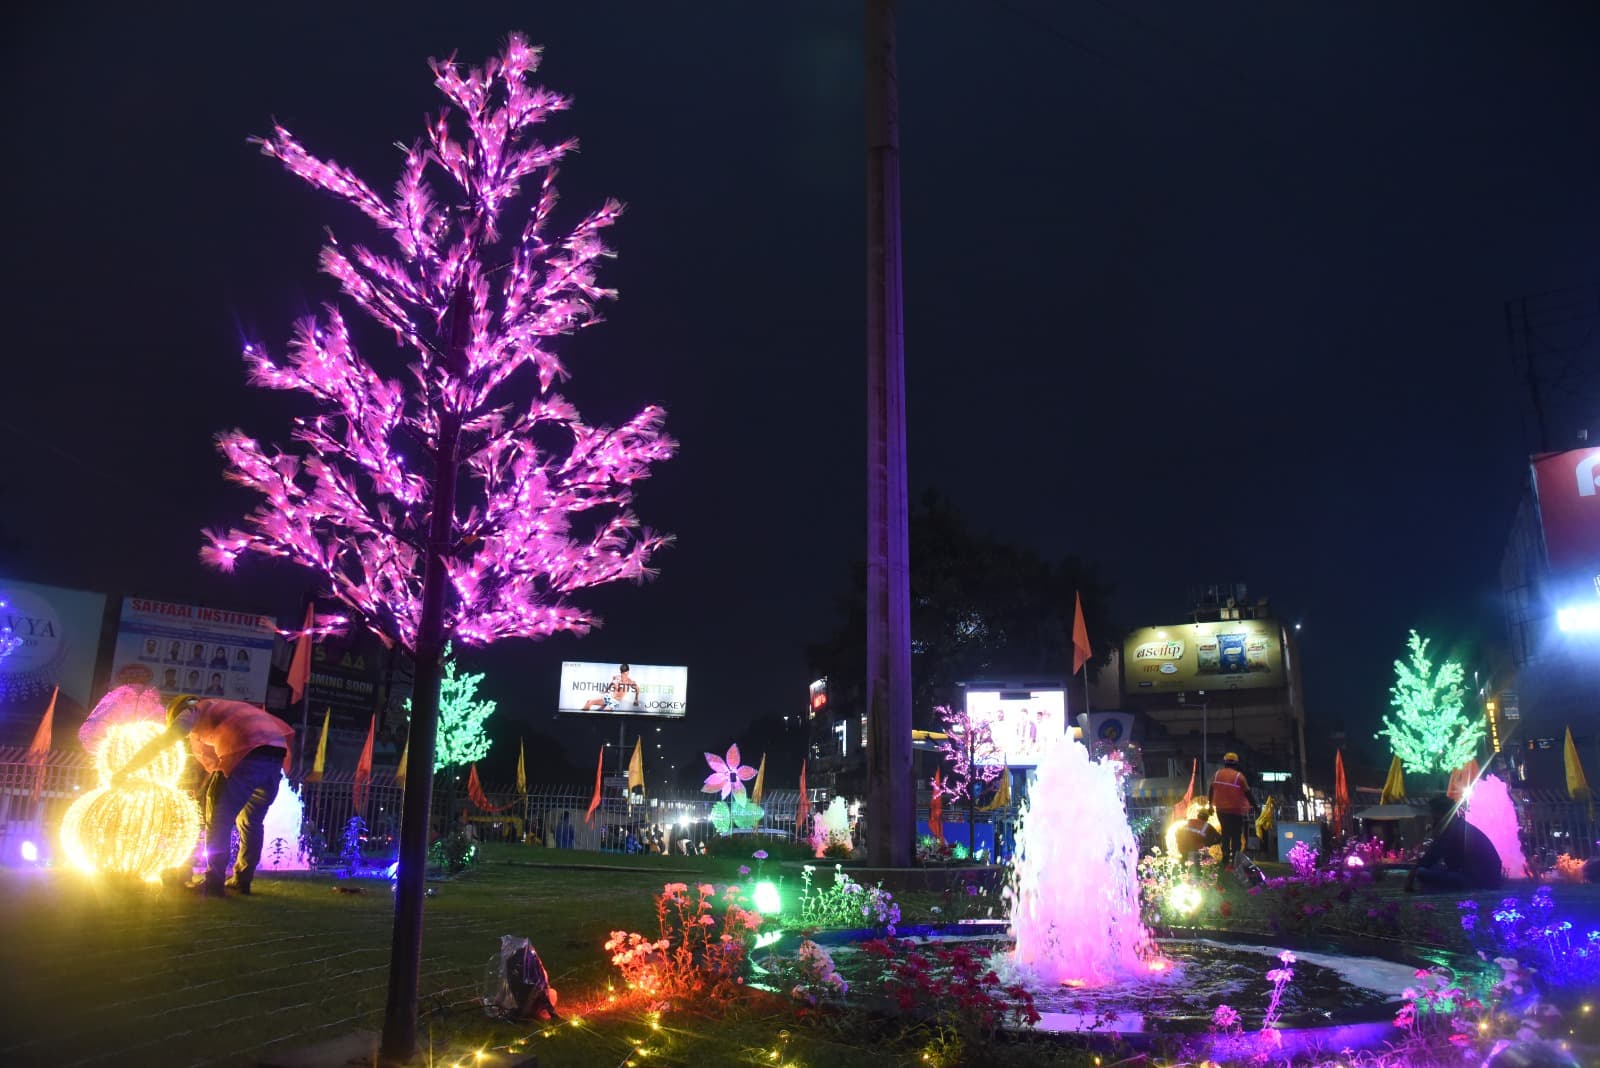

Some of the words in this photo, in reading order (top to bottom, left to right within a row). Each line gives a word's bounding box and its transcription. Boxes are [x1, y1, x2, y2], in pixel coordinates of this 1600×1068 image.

[572, 681, 616, 693] NOTHING
[618, 683, 637, 693] FITS
[644, 700, 686, 709] JOCKEY
